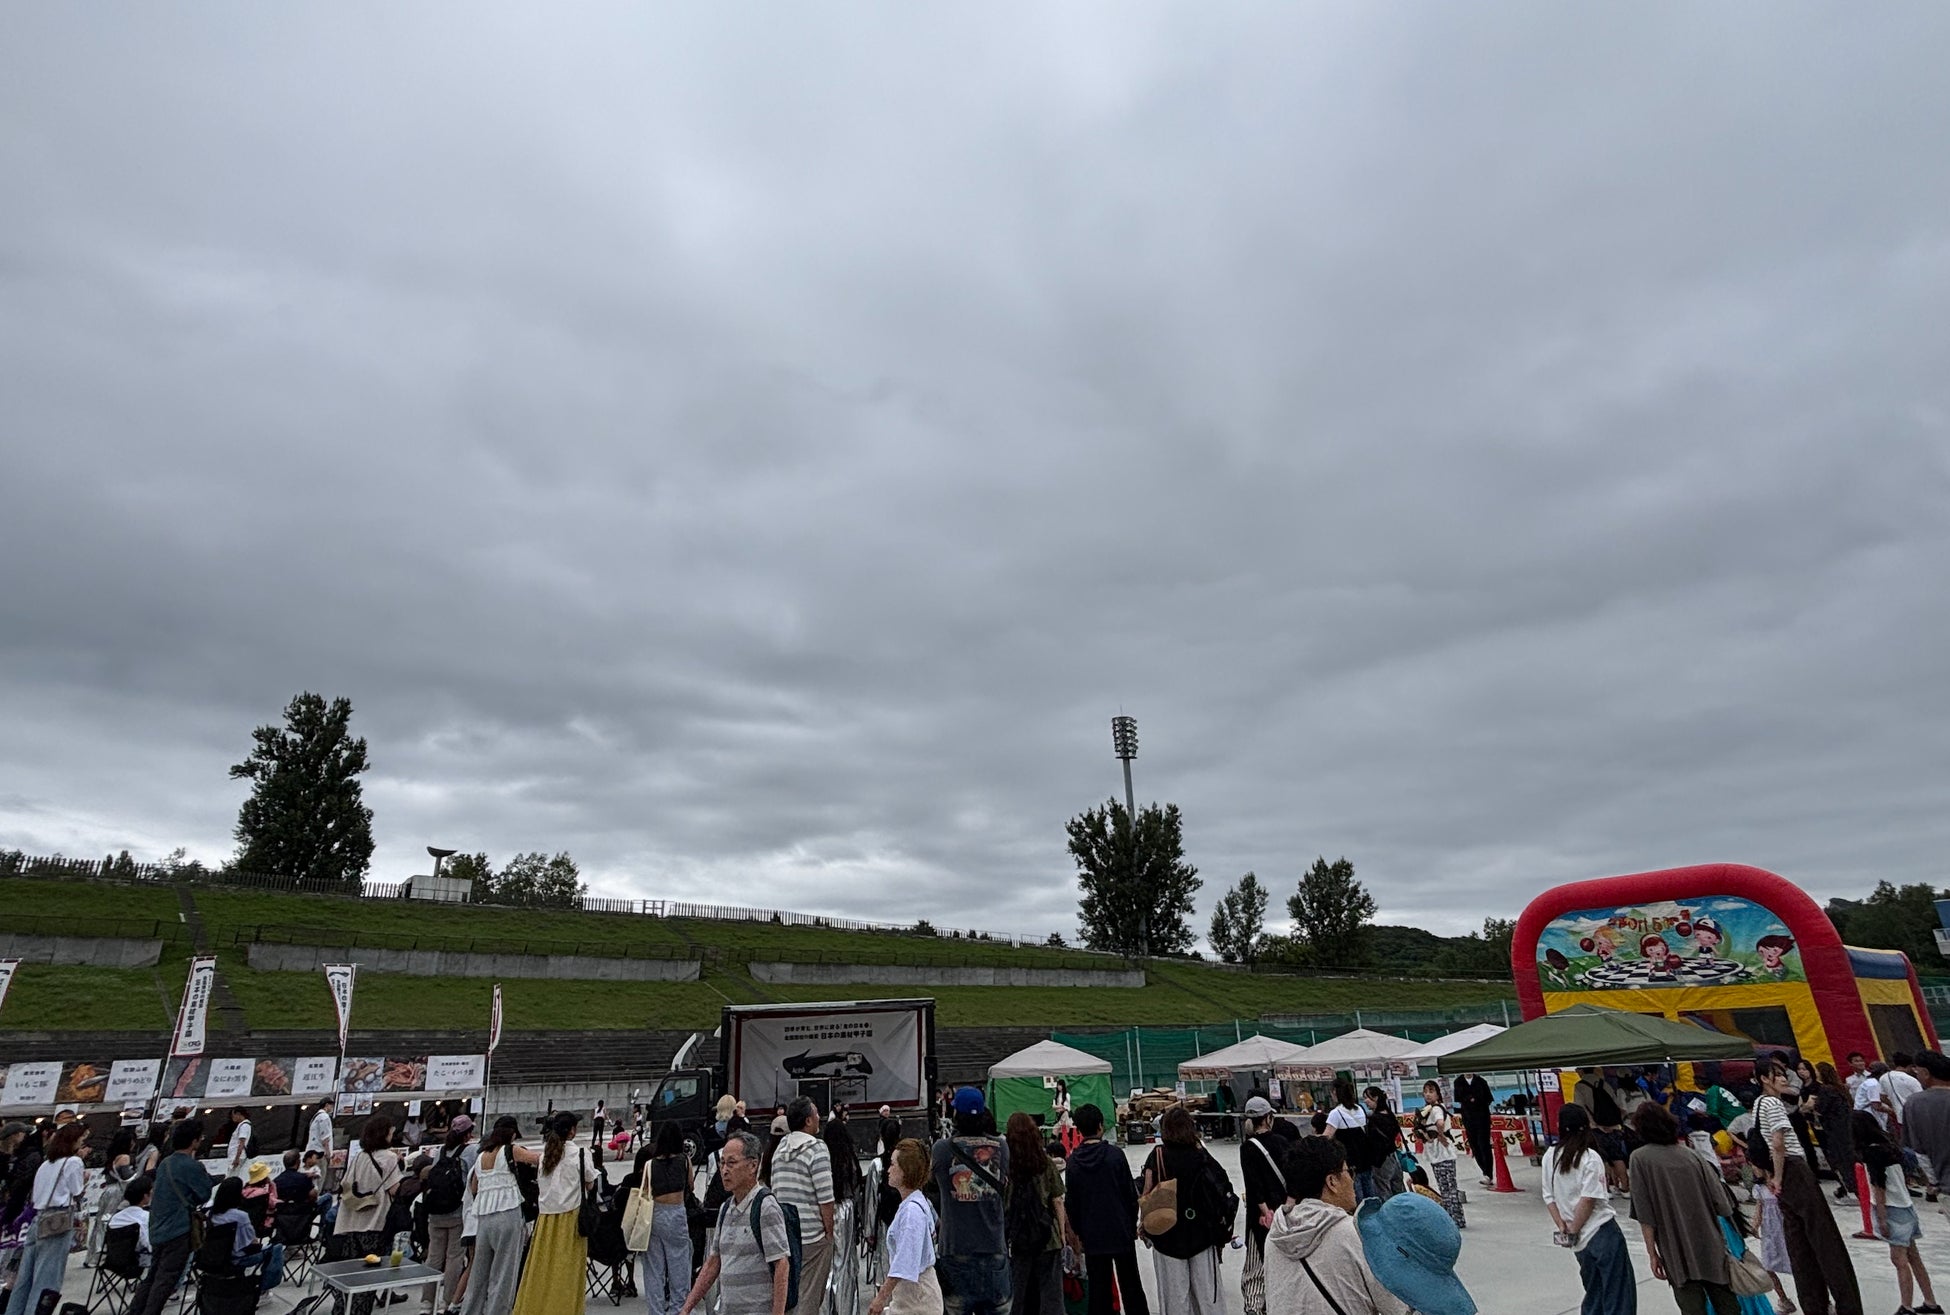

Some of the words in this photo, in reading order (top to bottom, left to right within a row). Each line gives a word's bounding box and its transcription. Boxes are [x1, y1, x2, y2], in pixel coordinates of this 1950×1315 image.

[212, 1074, 249, 1083] なにわ黒牛
[302, 1072, 325, 1082] 近江牛
